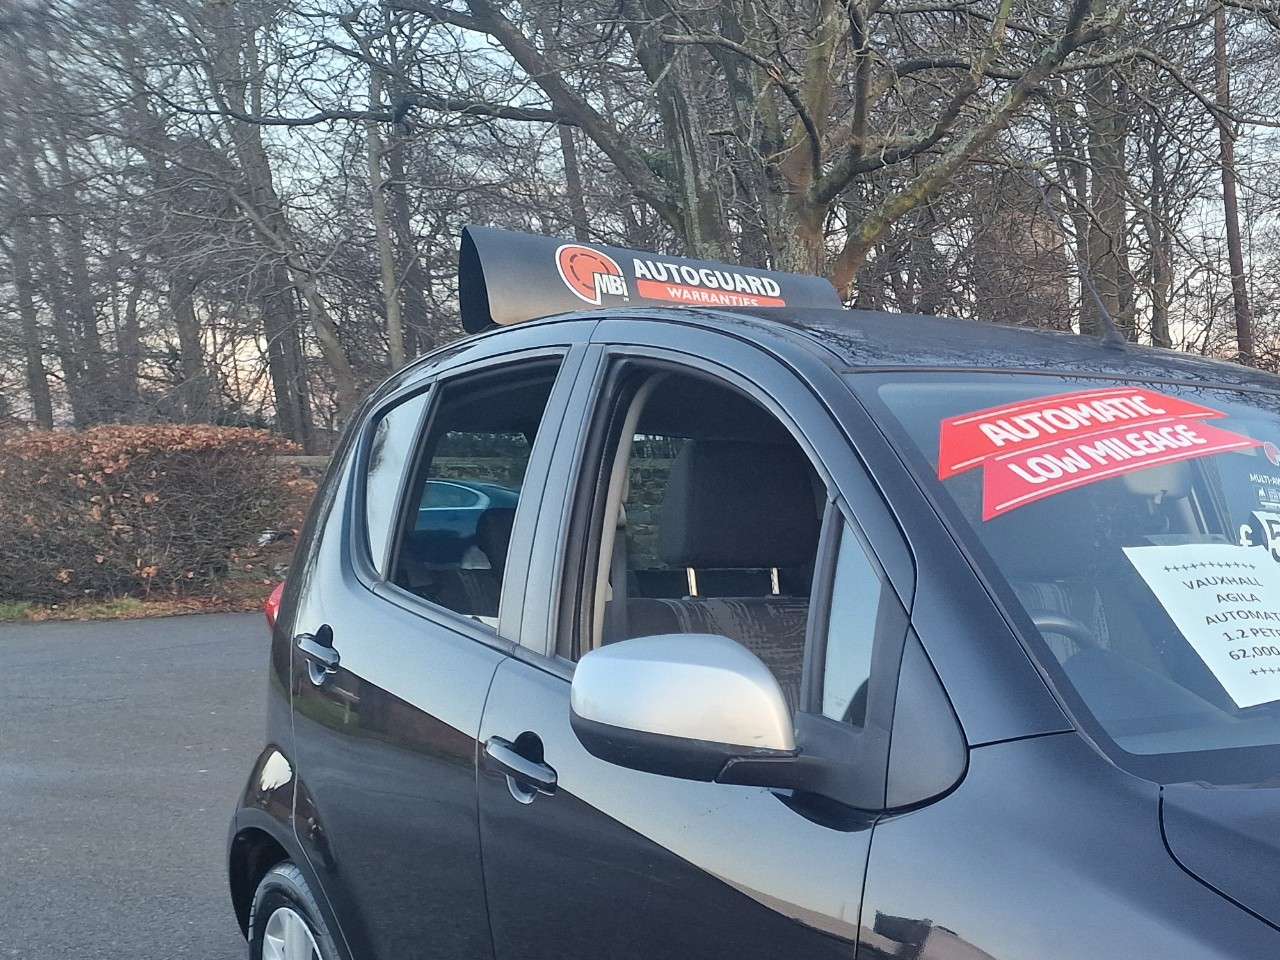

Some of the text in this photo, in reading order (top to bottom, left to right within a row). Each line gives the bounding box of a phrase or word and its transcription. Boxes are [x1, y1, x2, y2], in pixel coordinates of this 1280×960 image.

[632, 258, 781, 297] AUTOGUARD
[978, 395, 1167, 448] AUTOMATIC
[1007, 424, 1208, 484] LOW MILEAGE
[1182, 576, 1264, 590] VAUXHALL
[1216, 593, 1262, 604] AGILA
[1223, 629, 1250, 642] 1.2
[1229, 646, 1280, 661] 62,000
